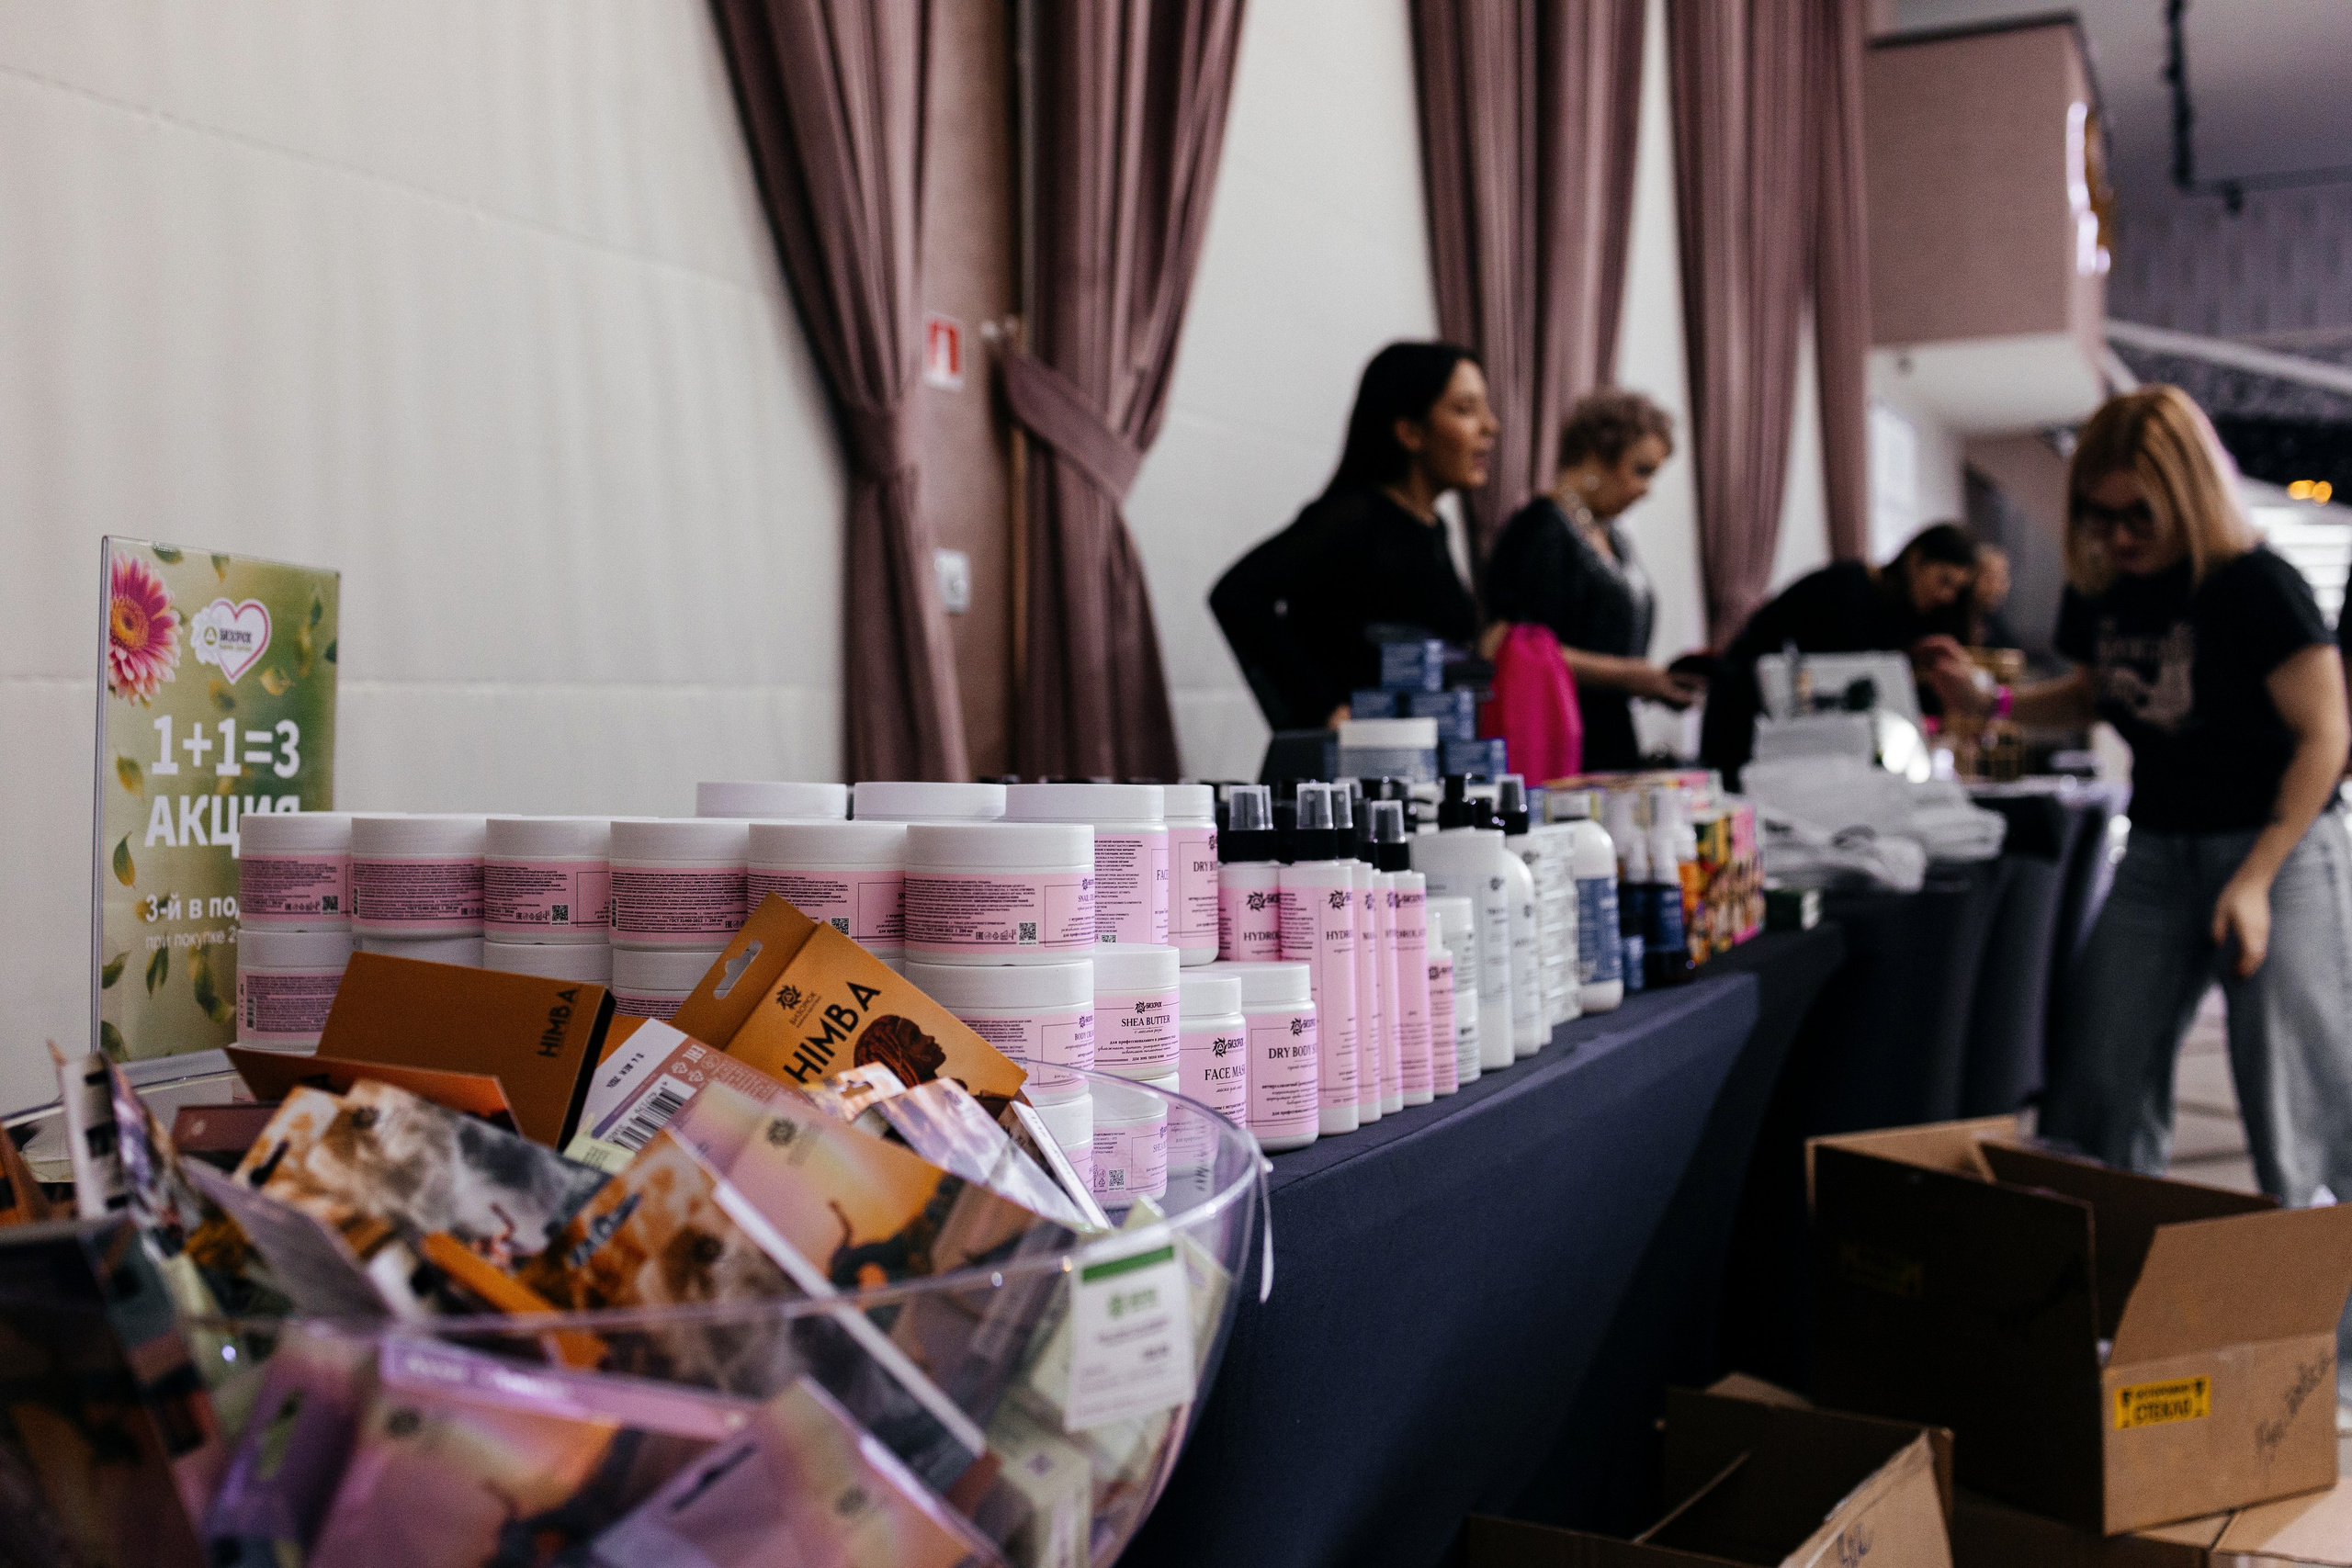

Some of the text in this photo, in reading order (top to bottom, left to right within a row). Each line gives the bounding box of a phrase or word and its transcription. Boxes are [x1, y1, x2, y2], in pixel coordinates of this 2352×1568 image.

[151, 715, 300, 779] 1+1=3
[145, 892, 182, 922] 3-й
[188, 898, 203, 919] в
[535, 985, 583, 1058] HIMBA
[783, 980, 882, 1085] HIMBA
[1121, 1014, 1171, 1028] SHEA BUTTER
[1268, 1047, 1291, 1059] DRY
[1292, 1045, 1312, 1058] BODY
[1204, 1067, 1231, 1081] FACE
